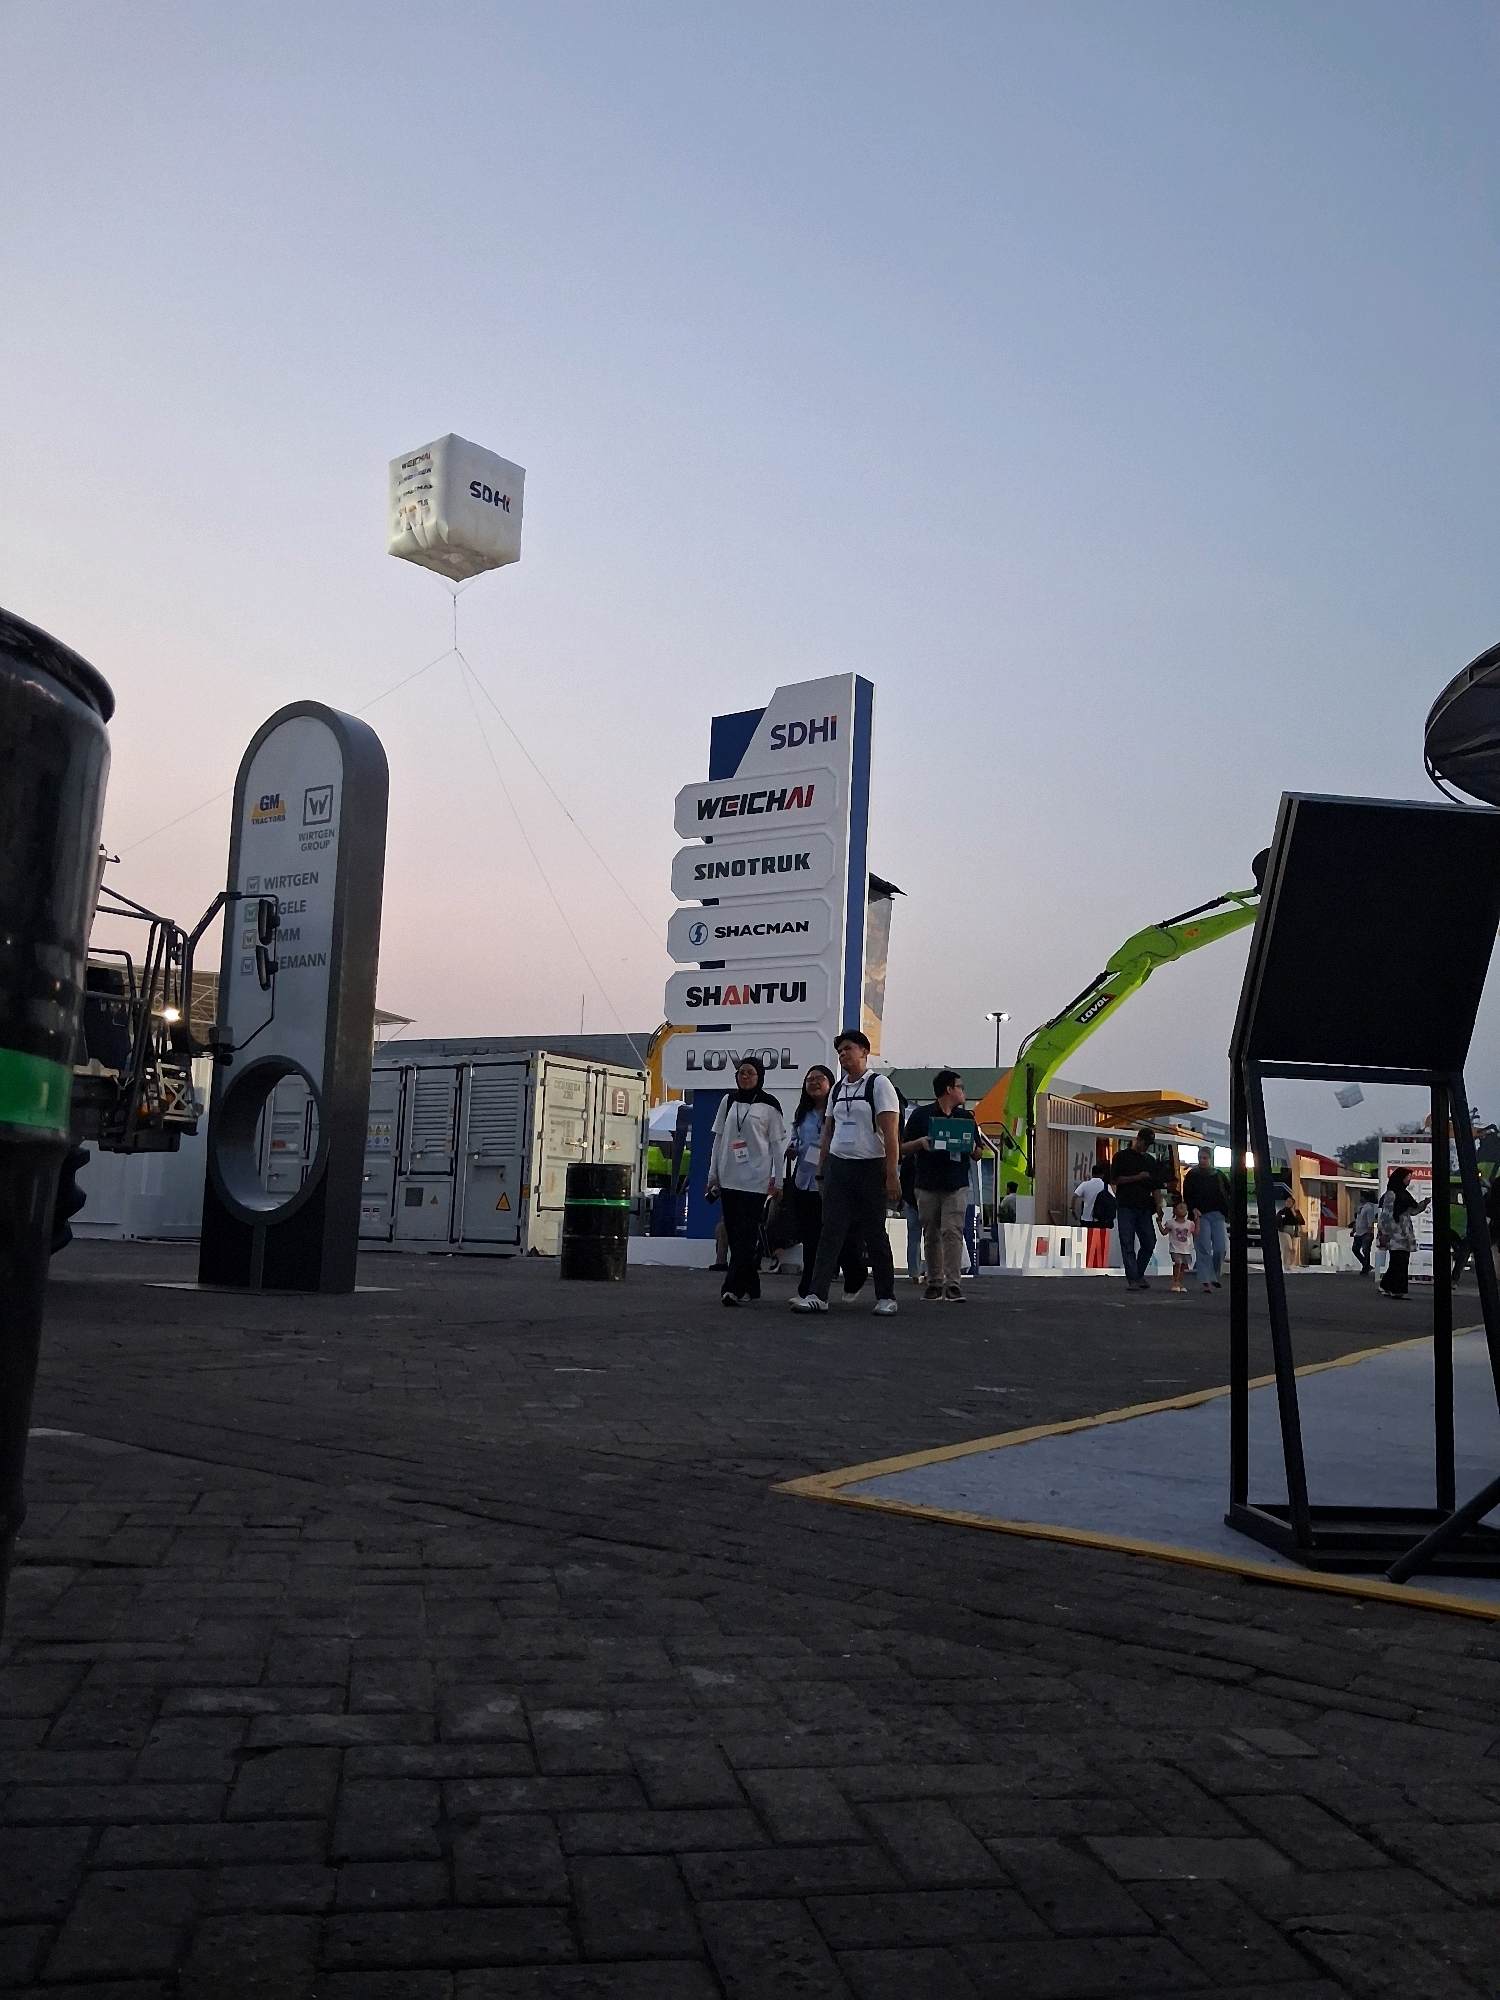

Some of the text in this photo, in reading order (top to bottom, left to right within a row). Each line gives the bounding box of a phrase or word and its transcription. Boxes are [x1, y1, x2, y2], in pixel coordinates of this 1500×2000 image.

[259, 793, 281, 812] GM
[697, 784, 815, 821] WEICHAI
[251, 813, 286, 826] TRACTORS
[298, 828, 336, 843] WIRTGEN
[300, 839, 331, 852] GROUP
[693, 852, 811, 881] SINOTRUK
[264, 871, 319, 890] WIRTGEN
[713, 920, 810, 939] SHACMAN
[685, 981, 807, 1008] SHANTUI
[1080, 996, 1110, 1023] LOVOL
